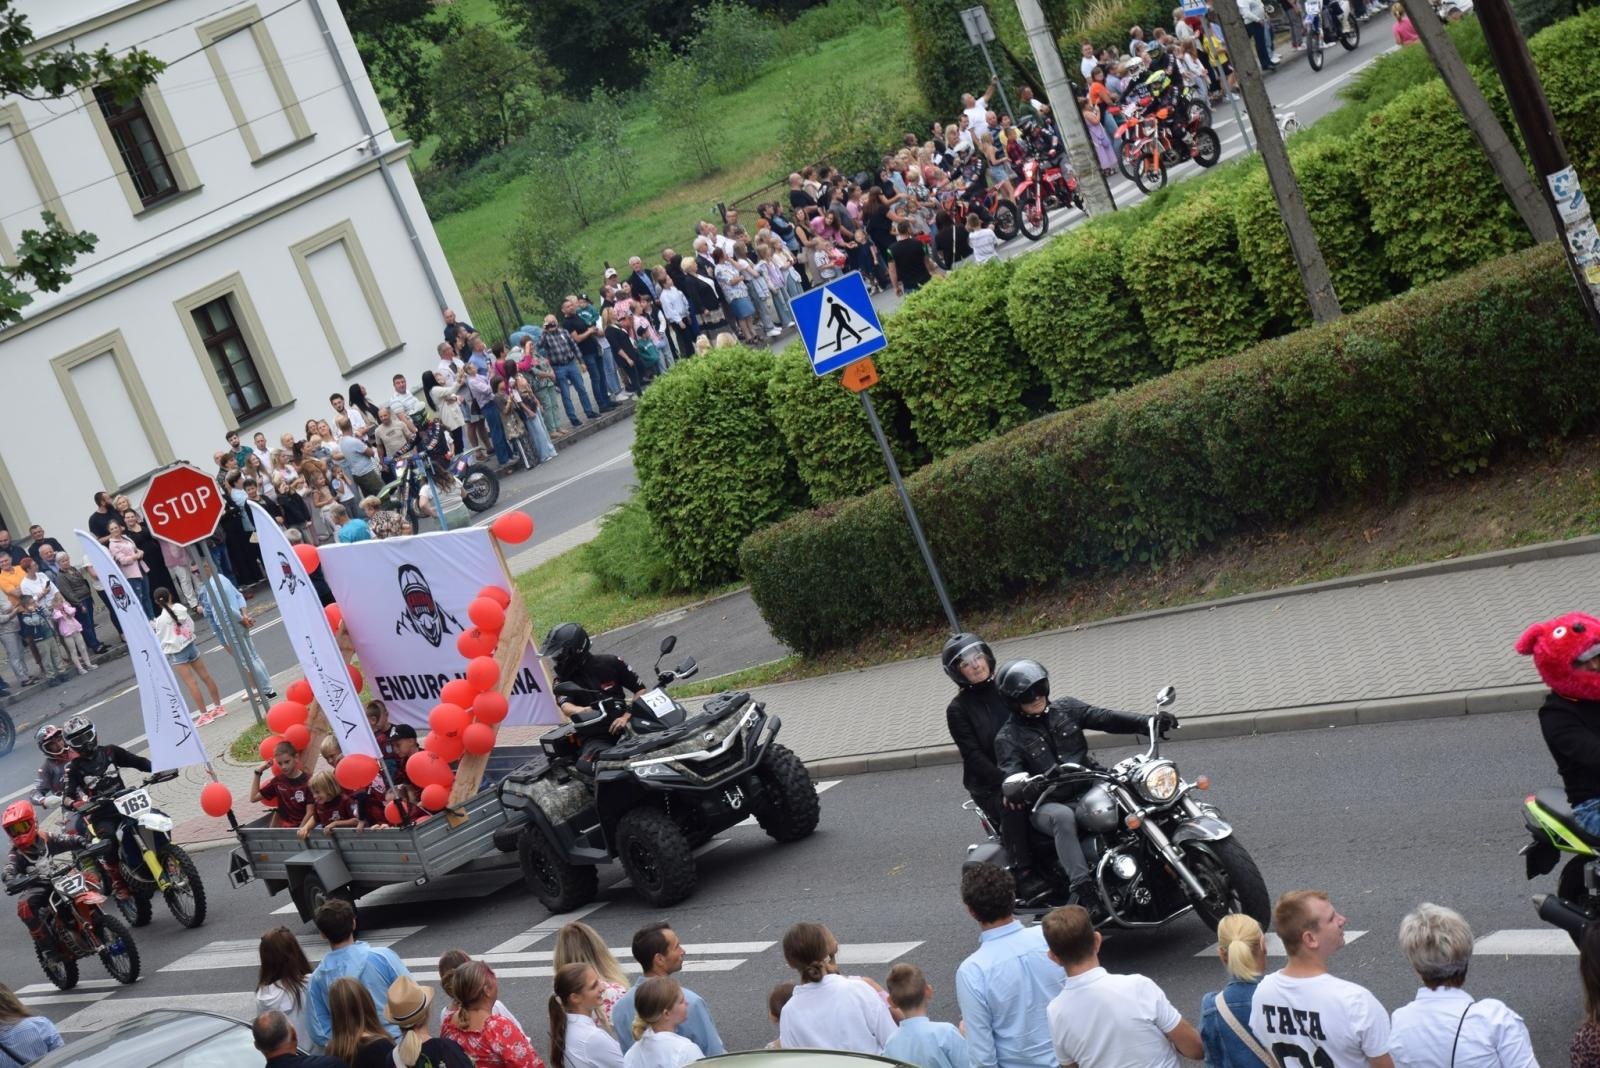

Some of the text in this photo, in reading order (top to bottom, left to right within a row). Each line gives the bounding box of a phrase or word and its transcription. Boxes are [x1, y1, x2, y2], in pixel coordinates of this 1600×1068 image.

[152, 486, 211, 525] STOP
[121, 794, 149, 815] 163
[61, 875, 83, 893] 27
[1262, 1004, 1326, 1041] TATA
